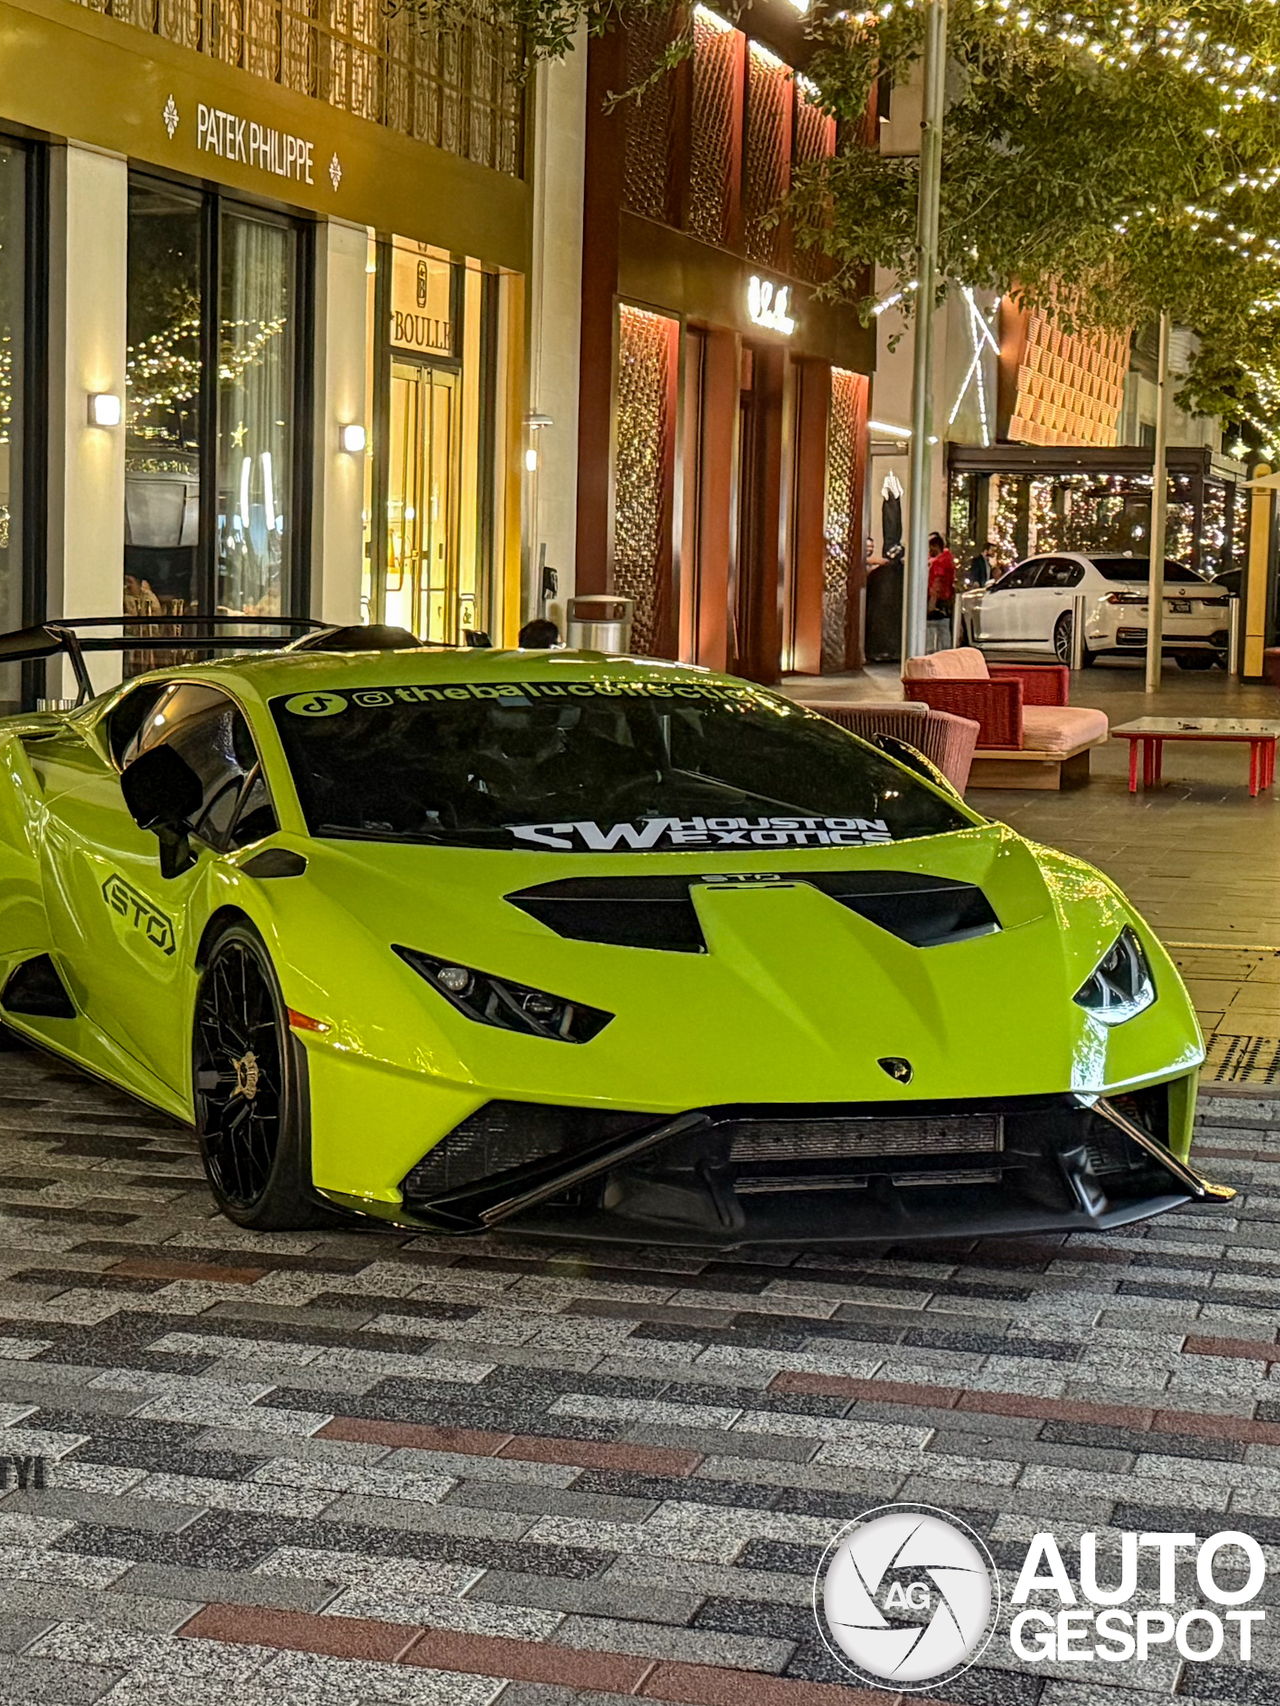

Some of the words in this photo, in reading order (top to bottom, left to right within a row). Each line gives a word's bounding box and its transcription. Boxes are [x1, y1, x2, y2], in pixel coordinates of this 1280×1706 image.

[197, 103, 247, 164] PATEK
[250, 121, 315, 186] PHILIPPE
[666, 829, 894, 845] EXOTICS
[669, 816, 889, 832] HOUSTON
[109, 882, 169, 949] STO
